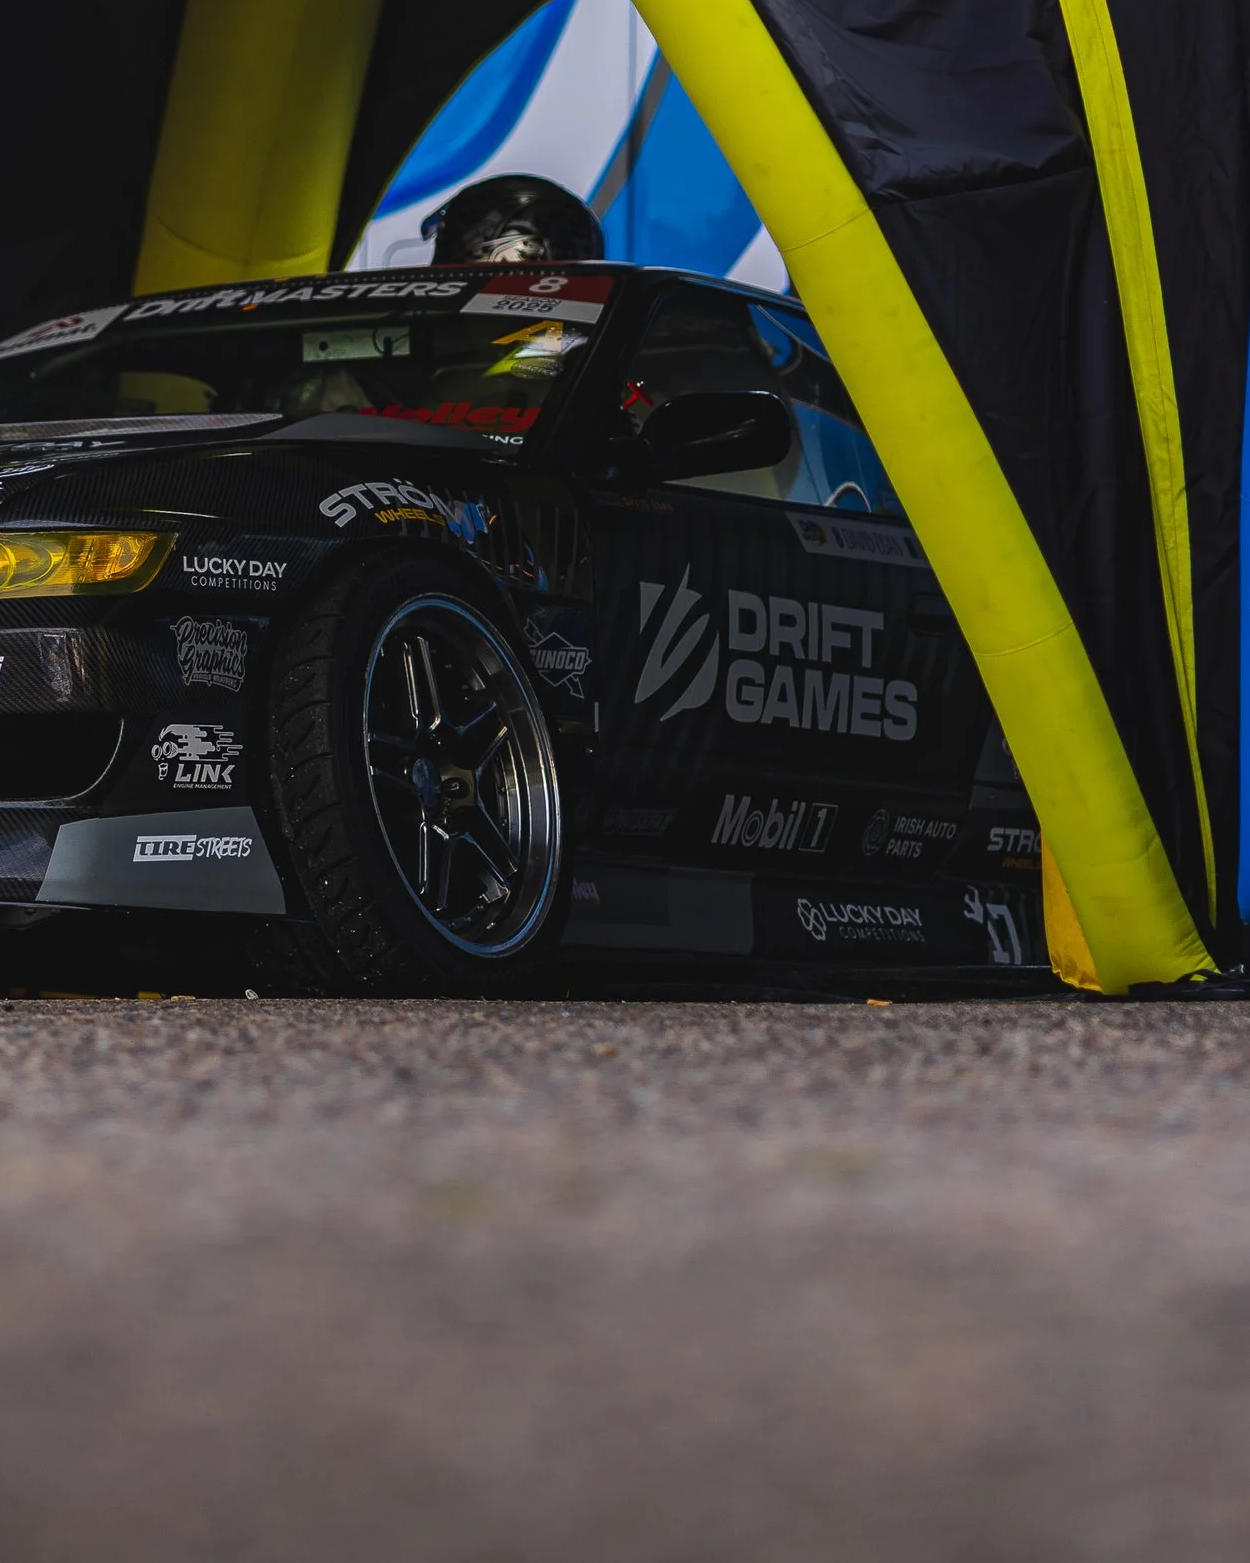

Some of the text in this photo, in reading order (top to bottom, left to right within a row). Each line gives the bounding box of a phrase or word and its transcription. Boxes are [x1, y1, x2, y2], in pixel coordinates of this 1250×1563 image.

[528, 276, 569, 294] 8
[492, 300, 554, 314] 2025
[374, 507, 447, 526] WHEELS
[182, 555, 288, 579] LUCKY DAY
[190, 575, 278, 592] COMPETITIONS
[170, 616, 248, 655] Precision
[728, 589, 885, 669] DRIFT
[177, 643, 246, 685] Graphics
[530, 648, 587, 671] UNOCO
[725, 659, 919, 742] GAMES
[174, 763, 236, 784] LINK
[172, 782, 194, 790] ENGINE
[710, 794, 806, 851] Mobil
[893, 816, 957, 840] IRISH AUTO
[885, 839, 923, 859] PARTS
[824, 902, 923, 928] LUCKY DAY
[838, 924, 926, 943] COMPETITIONS
